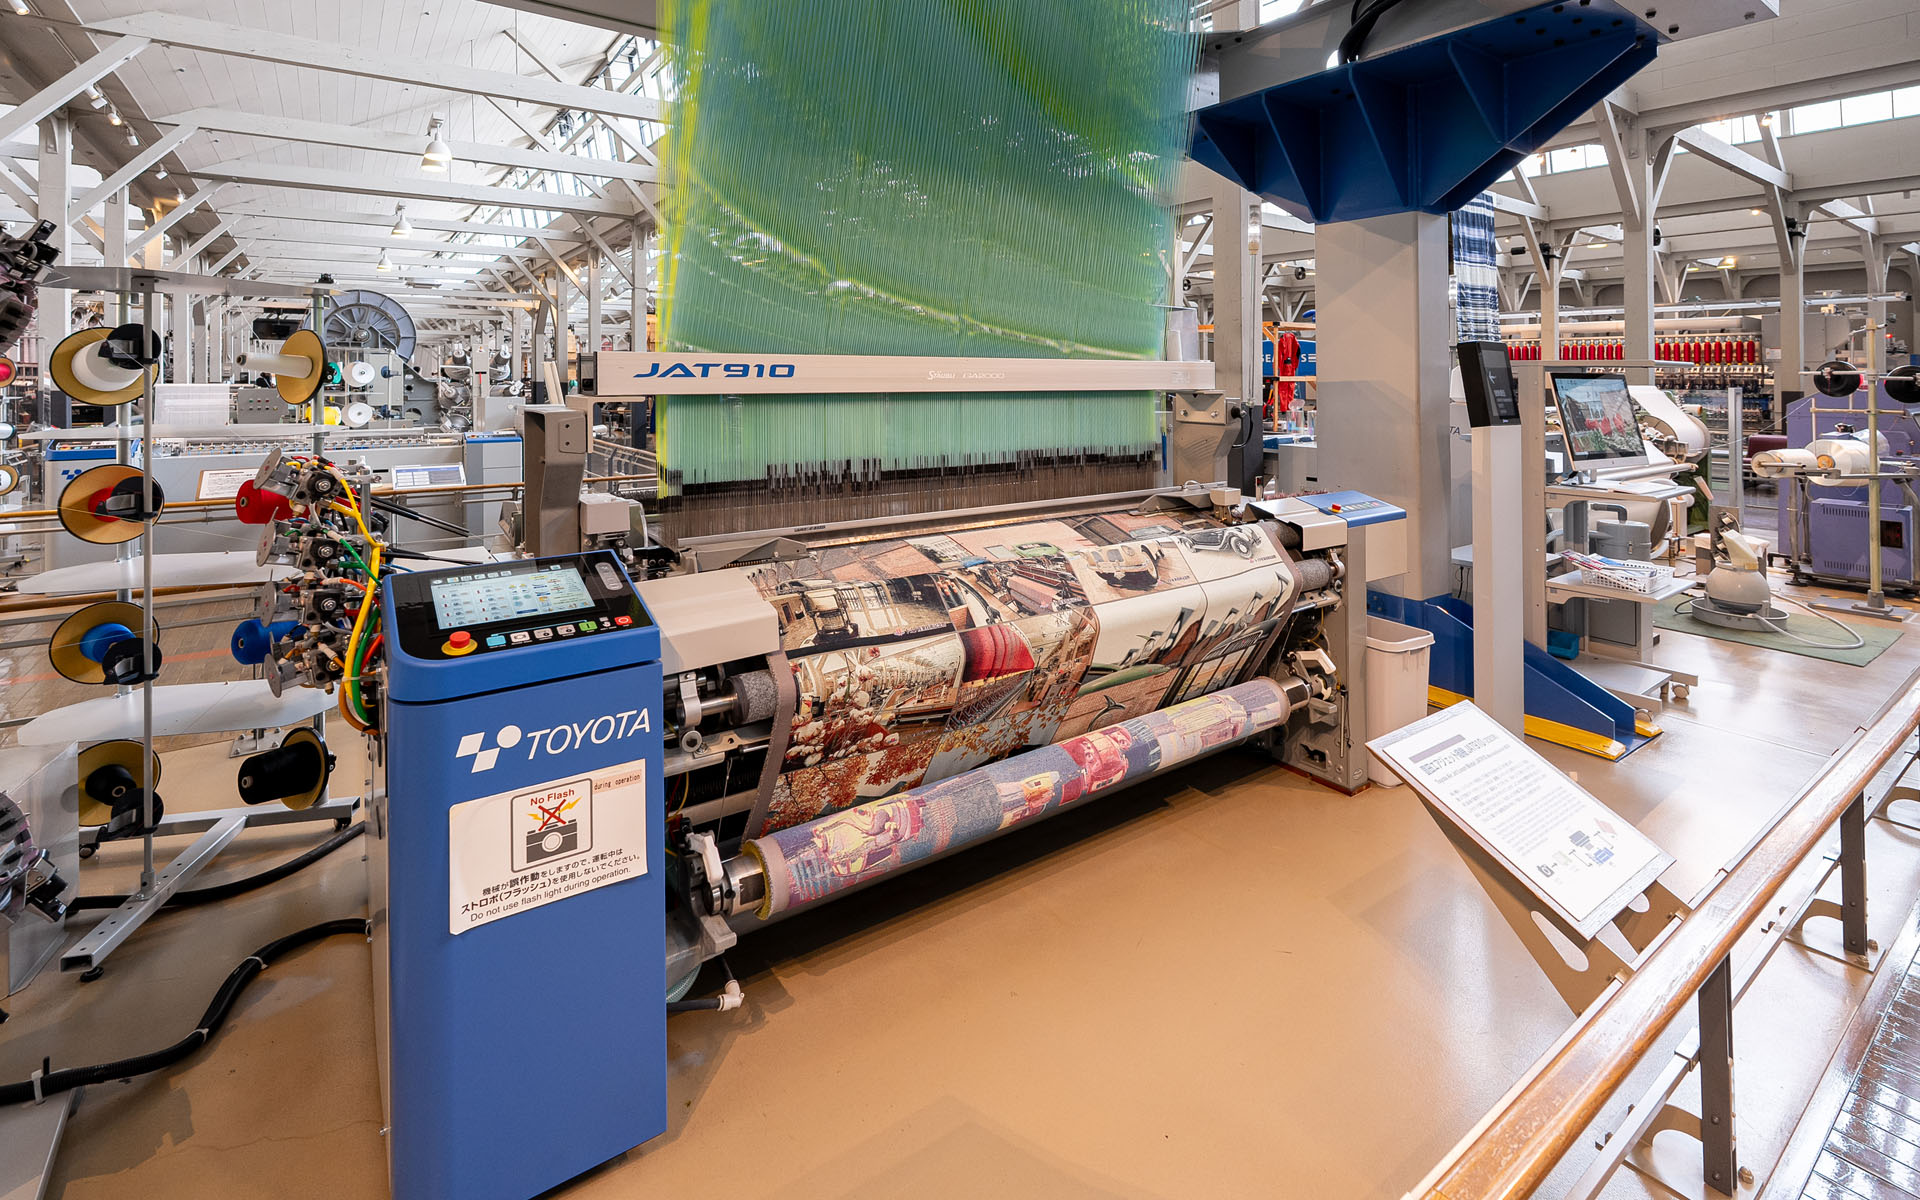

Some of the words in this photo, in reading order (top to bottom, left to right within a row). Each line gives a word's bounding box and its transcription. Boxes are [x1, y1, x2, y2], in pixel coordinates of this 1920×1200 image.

[633, 363, 795, 378] JAT910
[527, 707, 651, 760] TOYOTA
[594, 780, 611, 791] during
[615, 773, 641, 786] operation
[530, 796, 545, 806] No
[547, 788, 575, 802] Flash
[470, 912, 483, 922] Do
[486, 906, 501, 917] not
[503, 901, 519, 912] use
[521, 891, 542, 905] flash
[544, 886, 562, 901] light
[564, 878, 590, 893] during
[591, 867, 631, 884] operation.
